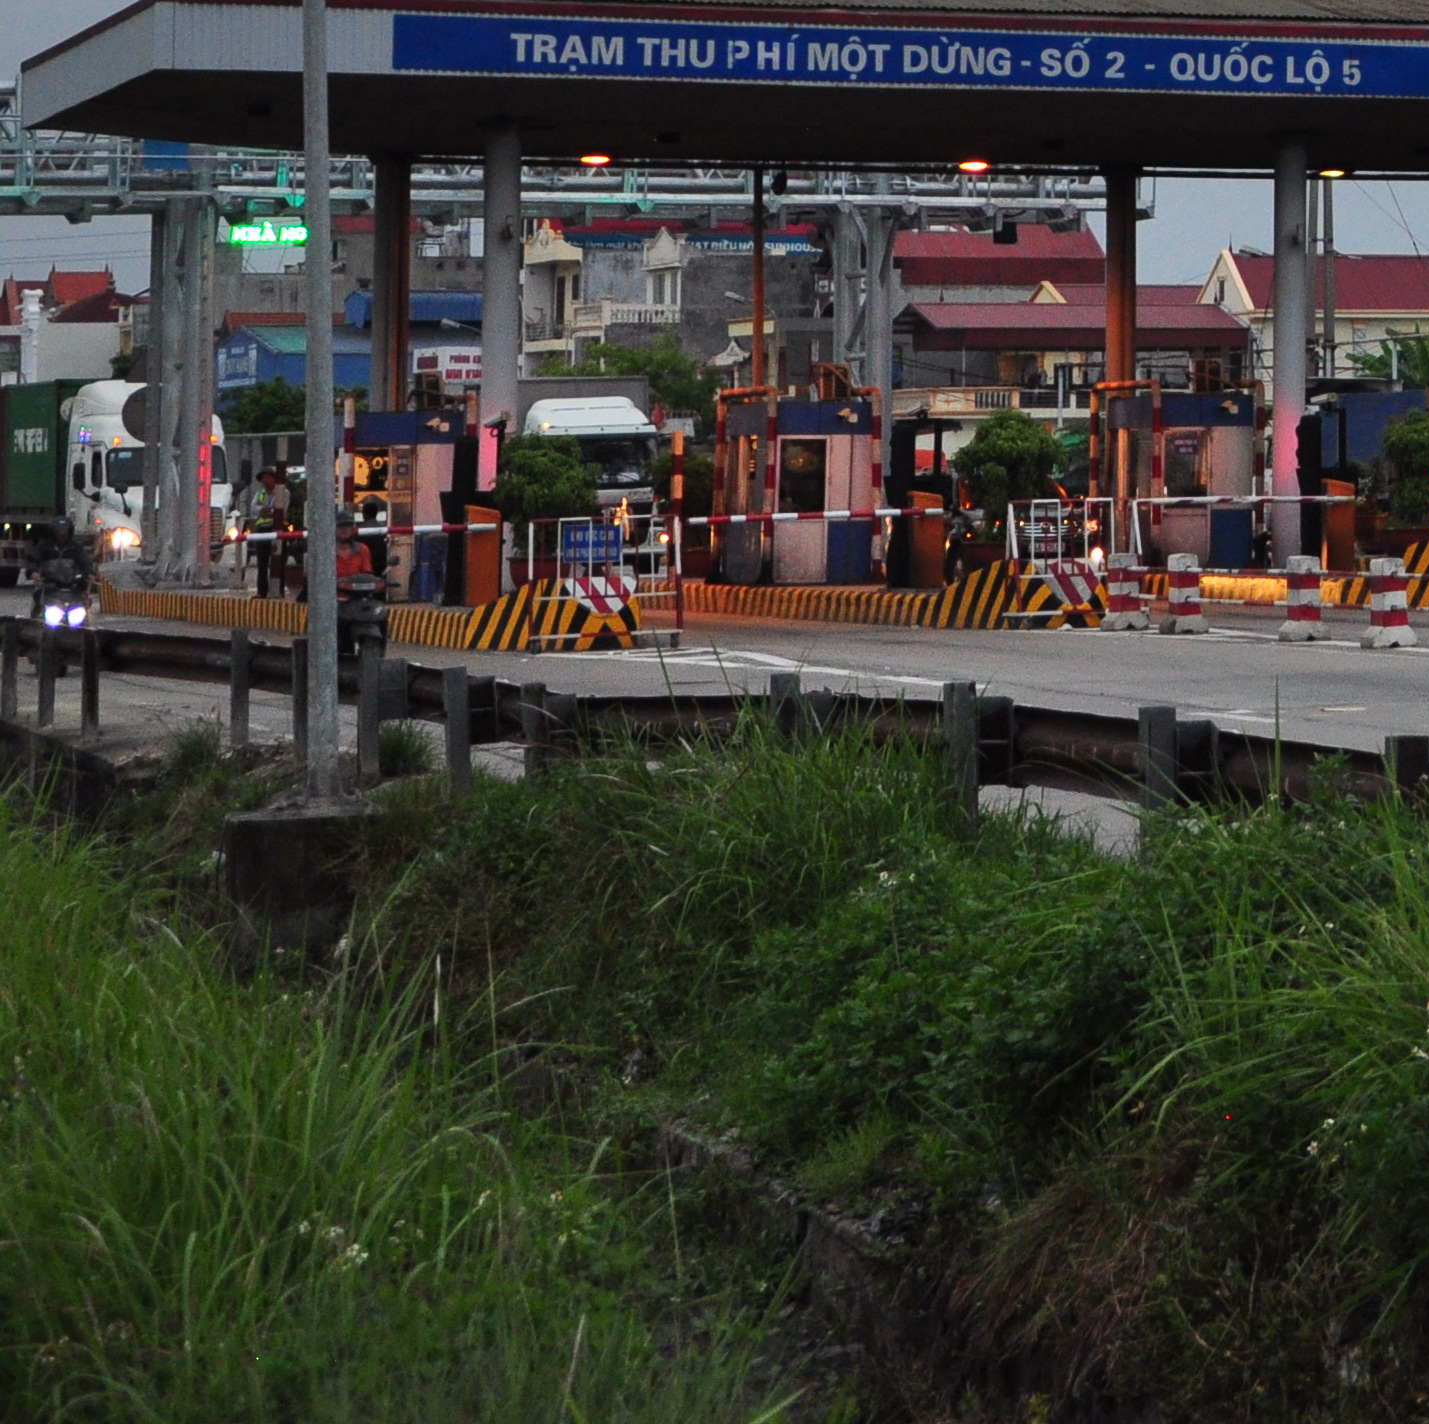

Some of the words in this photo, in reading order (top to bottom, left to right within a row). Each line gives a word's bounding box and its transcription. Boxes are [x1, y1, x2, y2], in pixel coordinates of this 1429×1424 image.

[510, 32, 624, 72] TRẠM
[637, 36, 716, 68] THU
[727, 33, 801, 71] PHÍ
[807, 35, 891, 80] MỘT
[903, 35, 1012, 76] DỪNG
[1041, 38, 1092, 77] SỐ
[1105, 52, 1125, 78] 2
[1169, 43, 1274, 83] QUỐC
[1286, 50, 1330, 91] LỘ
[1342, 60, 1362, 86] 5
